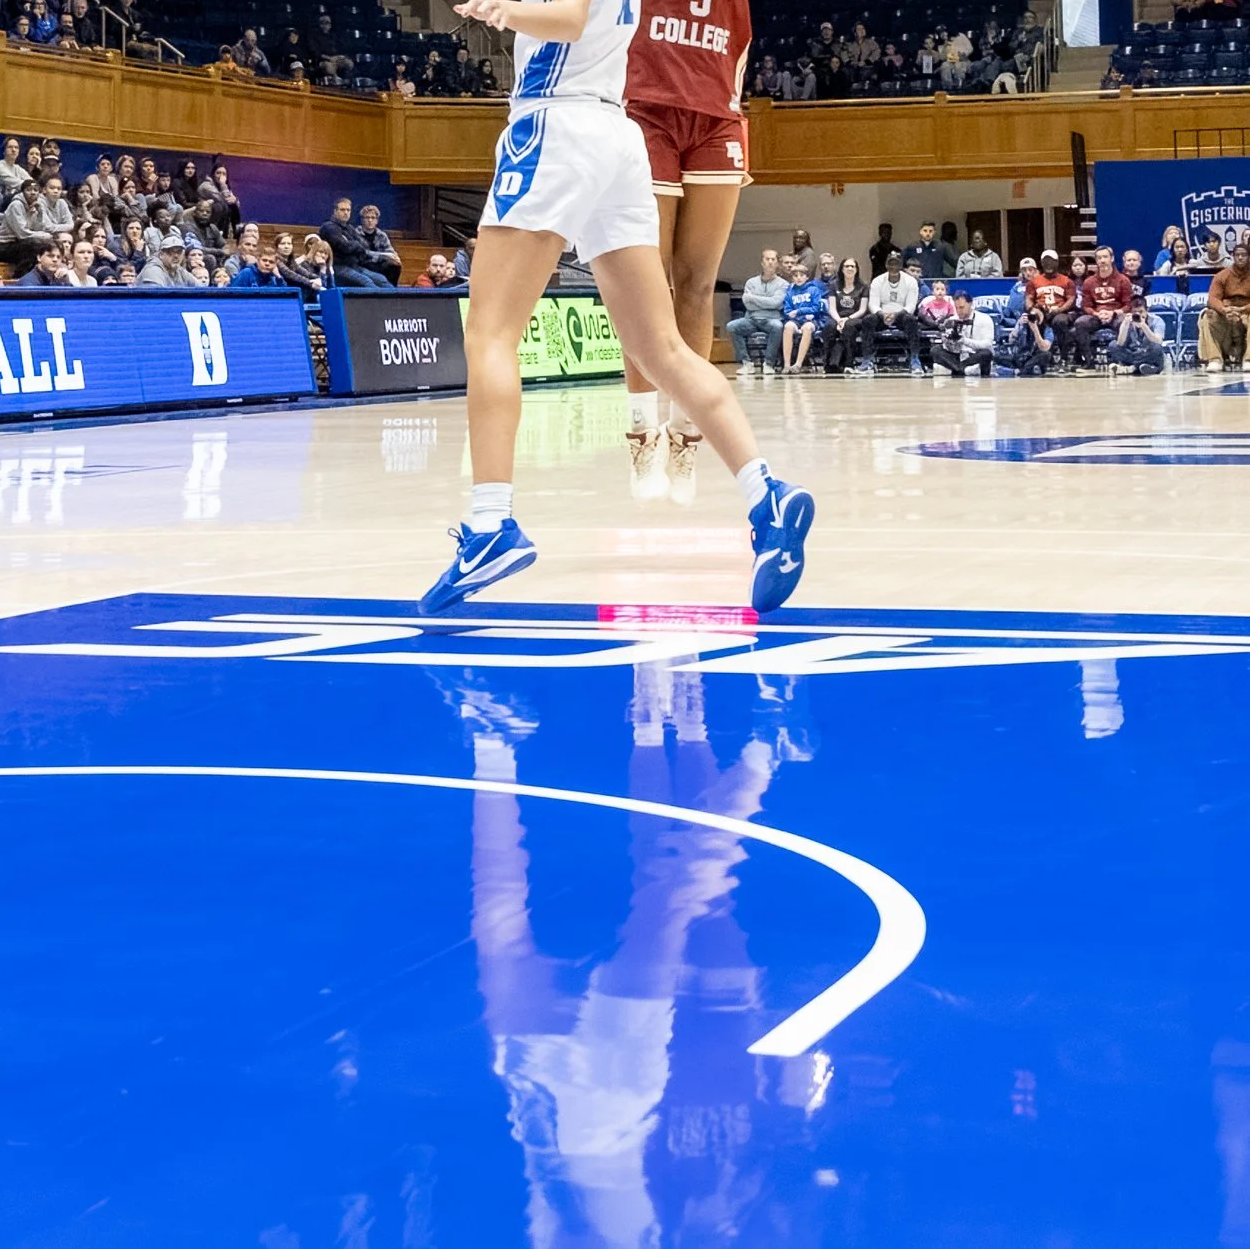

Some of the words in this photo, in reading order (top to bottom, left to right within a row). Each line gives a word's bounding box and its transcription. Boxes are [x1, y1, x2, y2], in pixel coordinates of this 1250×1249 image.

[649, 15, 731, 56] COLLEGE
[384, 318, 428, 333] MARRIOTT
[379, 337, 439, 366] BONVOY
